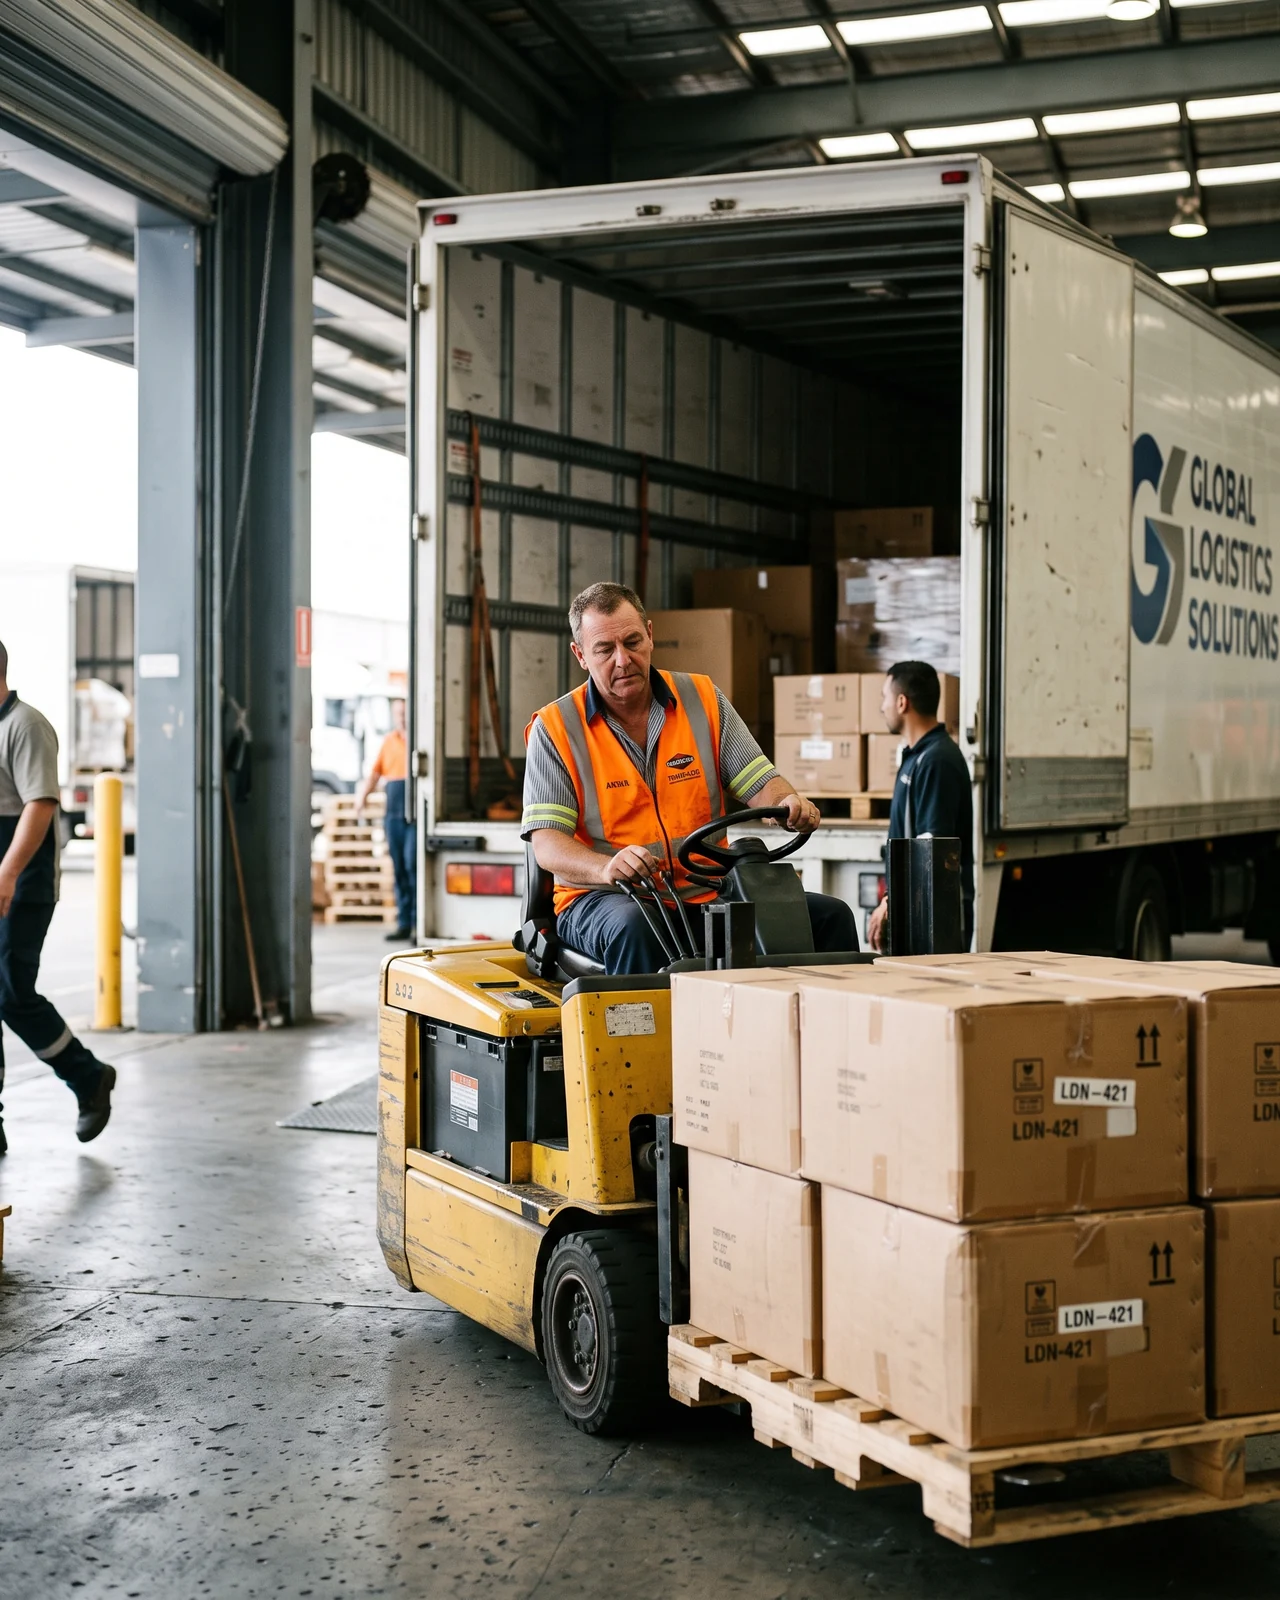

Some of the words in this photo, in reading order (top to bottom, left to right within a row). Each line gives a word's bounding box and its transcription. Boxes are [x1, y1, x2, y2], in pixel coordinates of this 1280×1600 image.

[1189, 454, 1256, 526] GLOBAL
[1189, 525, 1273, 596] LOGISTICS
[1188, 597, 1279, 662] SOLUTIONS
[1061, 1081, 1128, 1102] LDN-421
[1012, 1118, 1079, 1141] LDN-421
[1064, 1304, 1133, 1328] LDN-421
[1025, 1339, 1092, 1364] LDN-421
